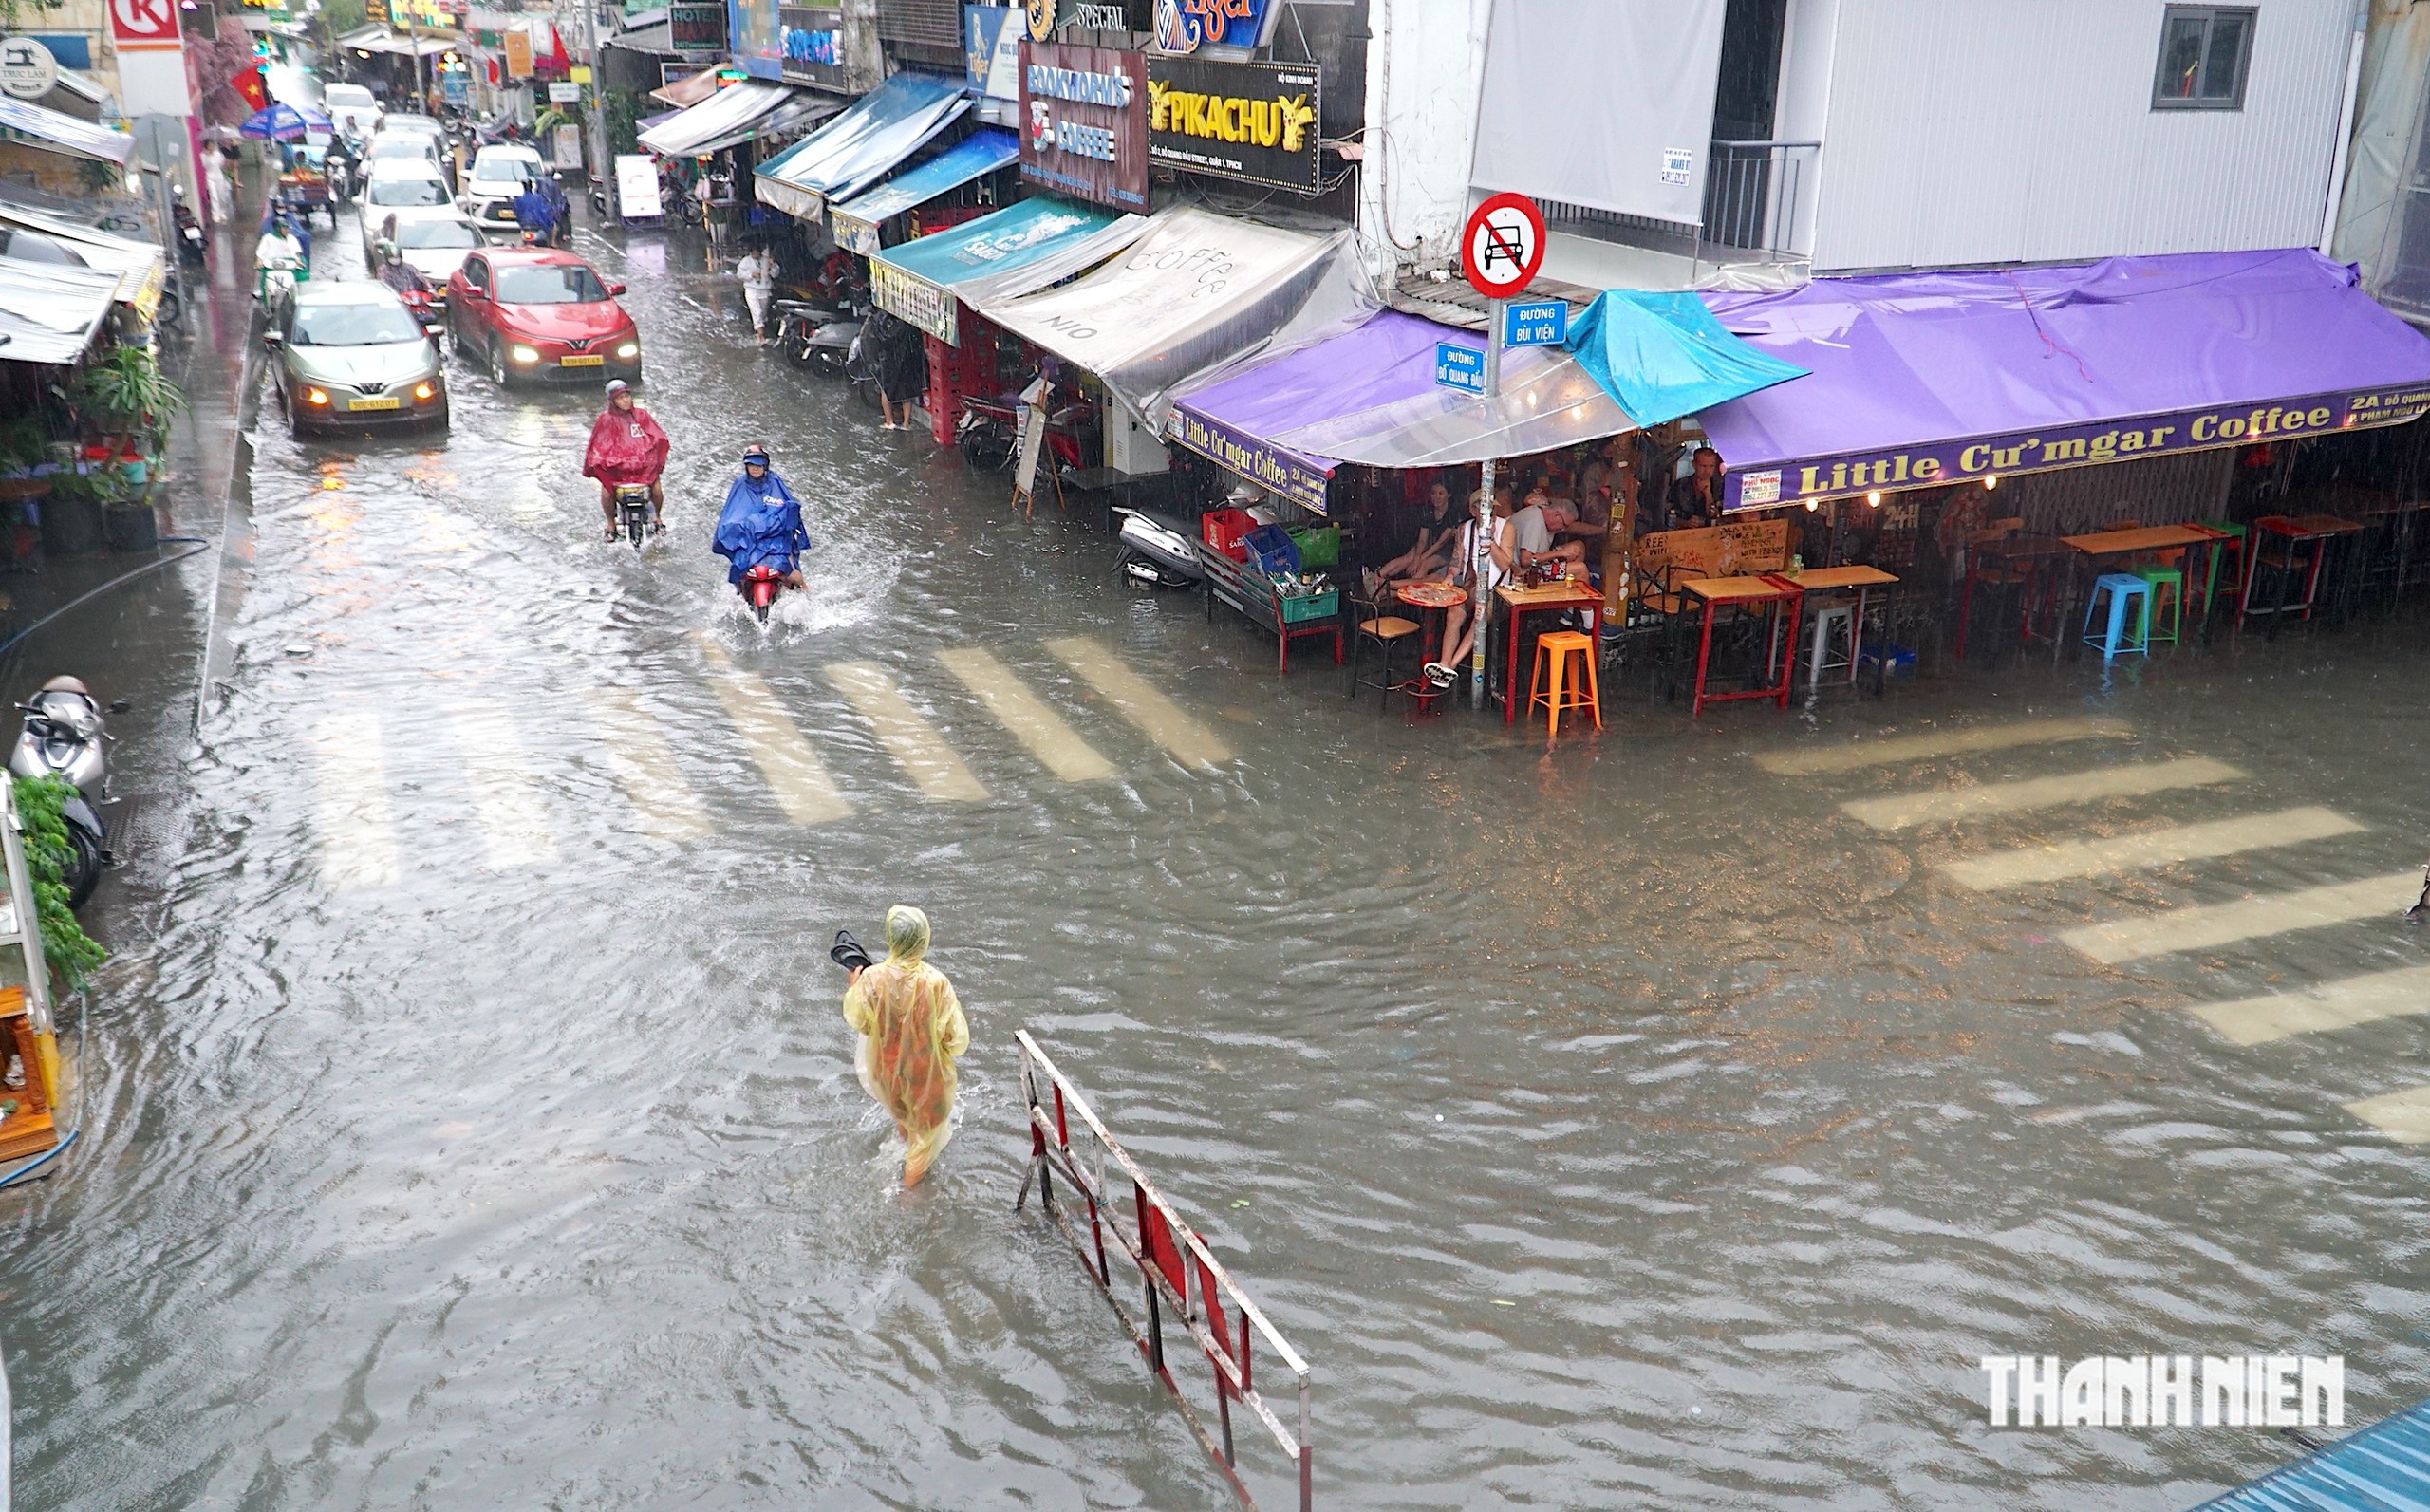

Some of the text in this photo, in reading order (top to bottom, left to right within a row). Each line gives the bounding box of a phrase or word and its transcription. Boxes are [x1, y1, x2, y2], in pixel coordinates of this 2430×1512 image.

[968, 51, 988, 83] Tiger
[1027, 65, 1131, 108] BOOKWORM'S
[1285, 75, 1297, 84] KINH
[1298, 75, 1313, 85] DOANH
[1169, 90, 1280, 147] PIKACHU
[1056, 121, 1115, 161] COFFEE
[1520, 308, 1555, 321] ĐƯỜNG
[1039, 315, 1097, 339] NIO
[1516, 324, 1555, 342] BÙI VIỆN
[1447, 350, 1475, 366] ĐƯỜNG
[1449, 368, 1469, 384] QUANG
[2351, 396, 2379, 410] 2A
[1186, 416, 1209, 449] Little
[1254, 450, 1288, 488] Coffee
[1798, 454, 1941, 495] Little
[2191, 406, 2331, 442] Coffee
